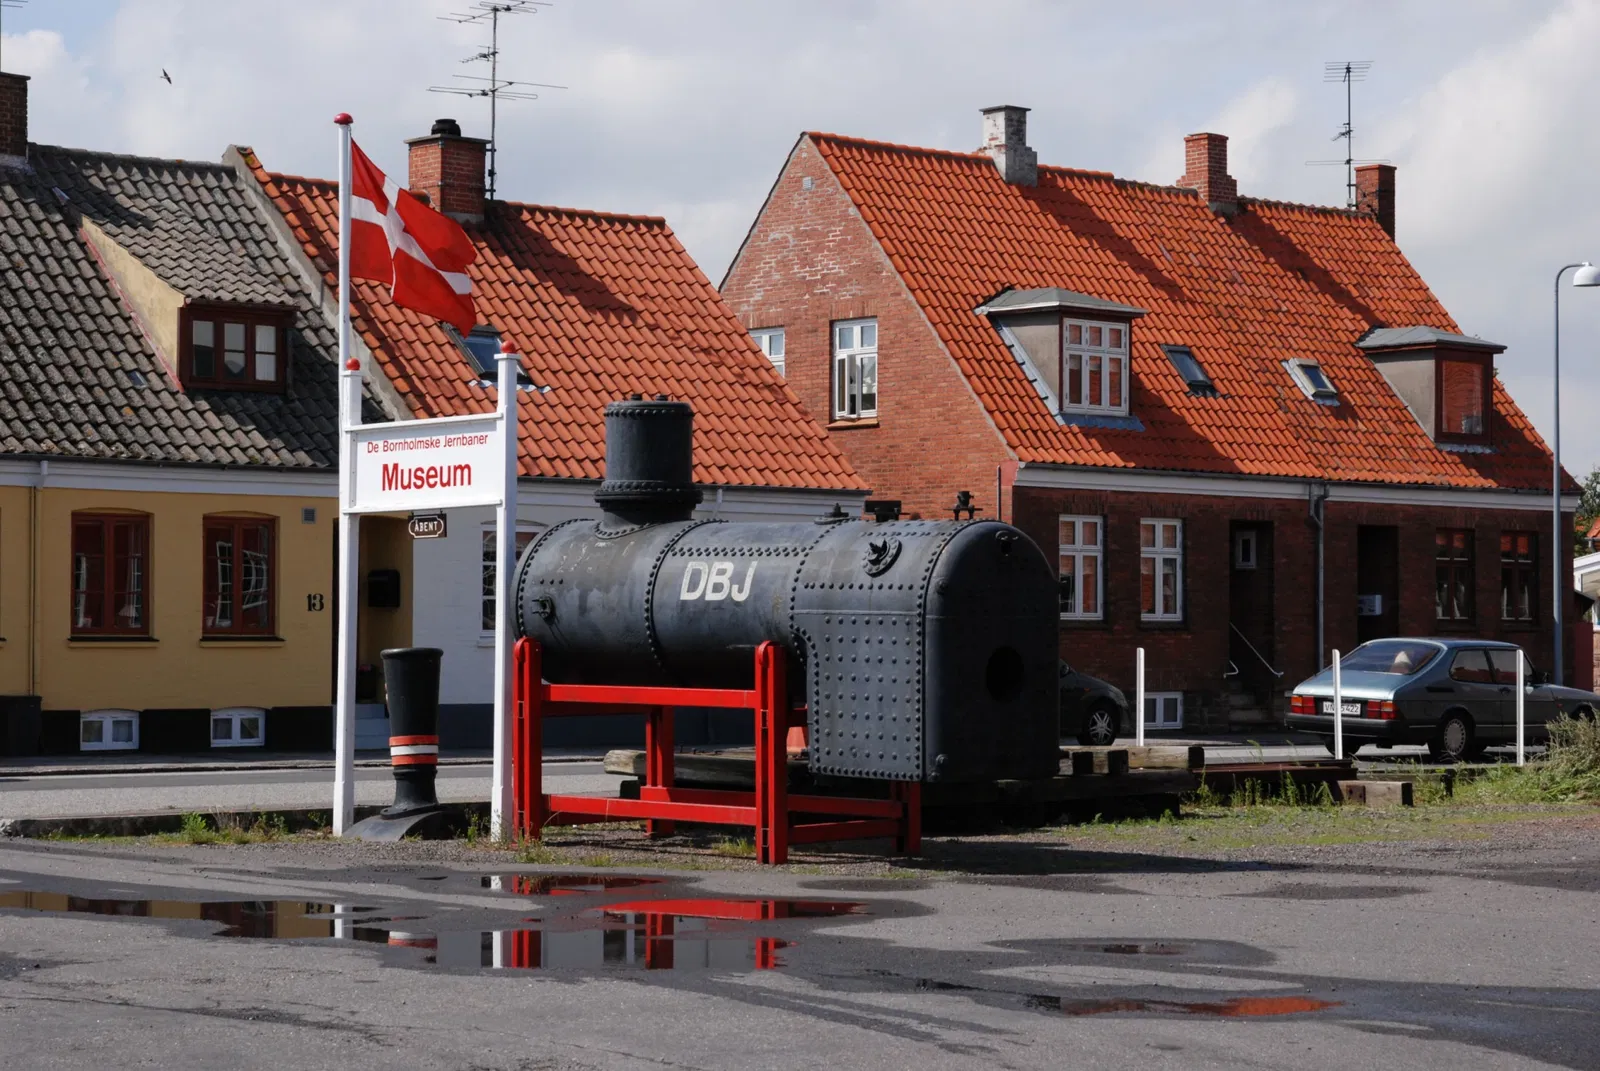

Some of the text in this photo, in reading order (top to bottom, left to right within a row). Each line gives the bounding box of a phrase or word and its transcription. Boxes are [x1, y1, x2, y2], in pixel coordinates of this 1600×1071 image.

[367, 434, 488, 453] De Bornholmske Jernbaner
[382, 462, 472, 491] Museum
[414, 519, 438, 532] ÅBENT
[680, 560, 758, 602] DBJ
[307, 593, 324, 611] 13
